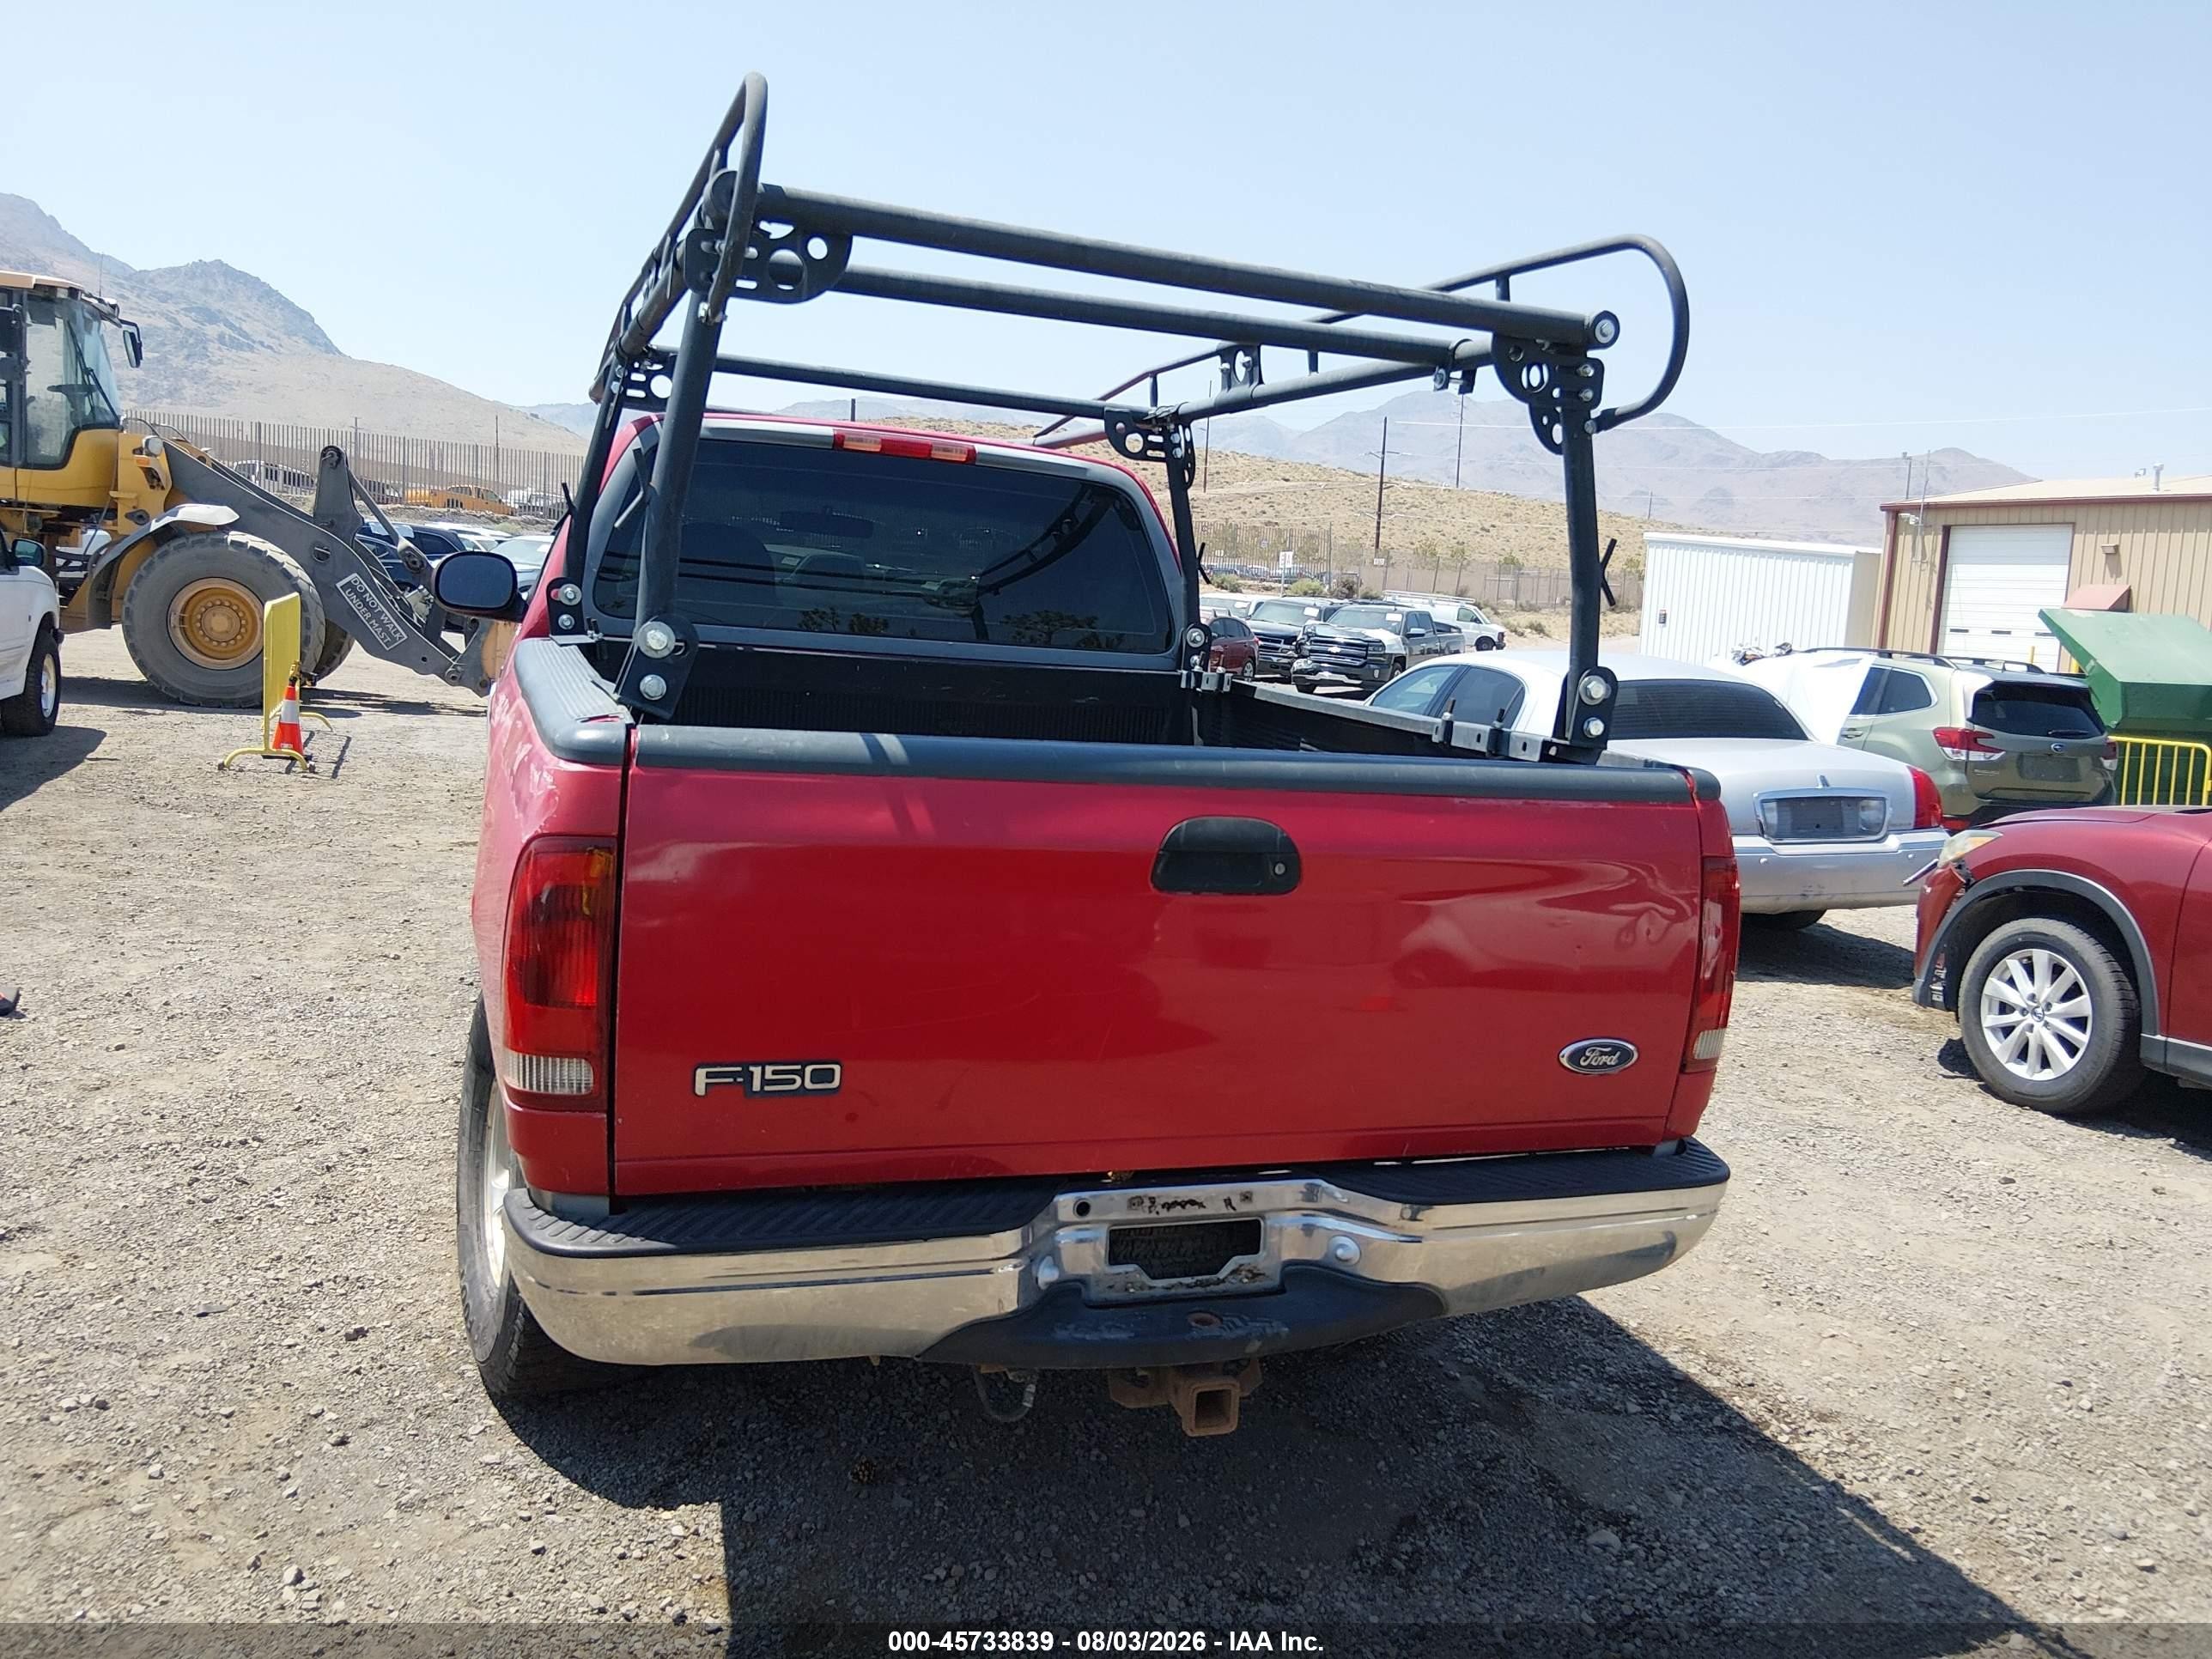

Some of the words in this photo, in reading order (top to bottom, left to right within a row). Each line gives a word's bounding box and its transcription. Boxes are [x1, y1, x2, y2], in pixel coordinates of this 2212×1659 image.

[345, 588, 372, 620] UNDER
[370, 619, 392, 642] MAST
[351, 578, 366, 592] DO
[362, 595, 383, 613] NOT
[381, 613, 403, 641] WALK
[1579, 1046, 1621, 1066] Ford
[694, 1063, 842, 1097] F-150
